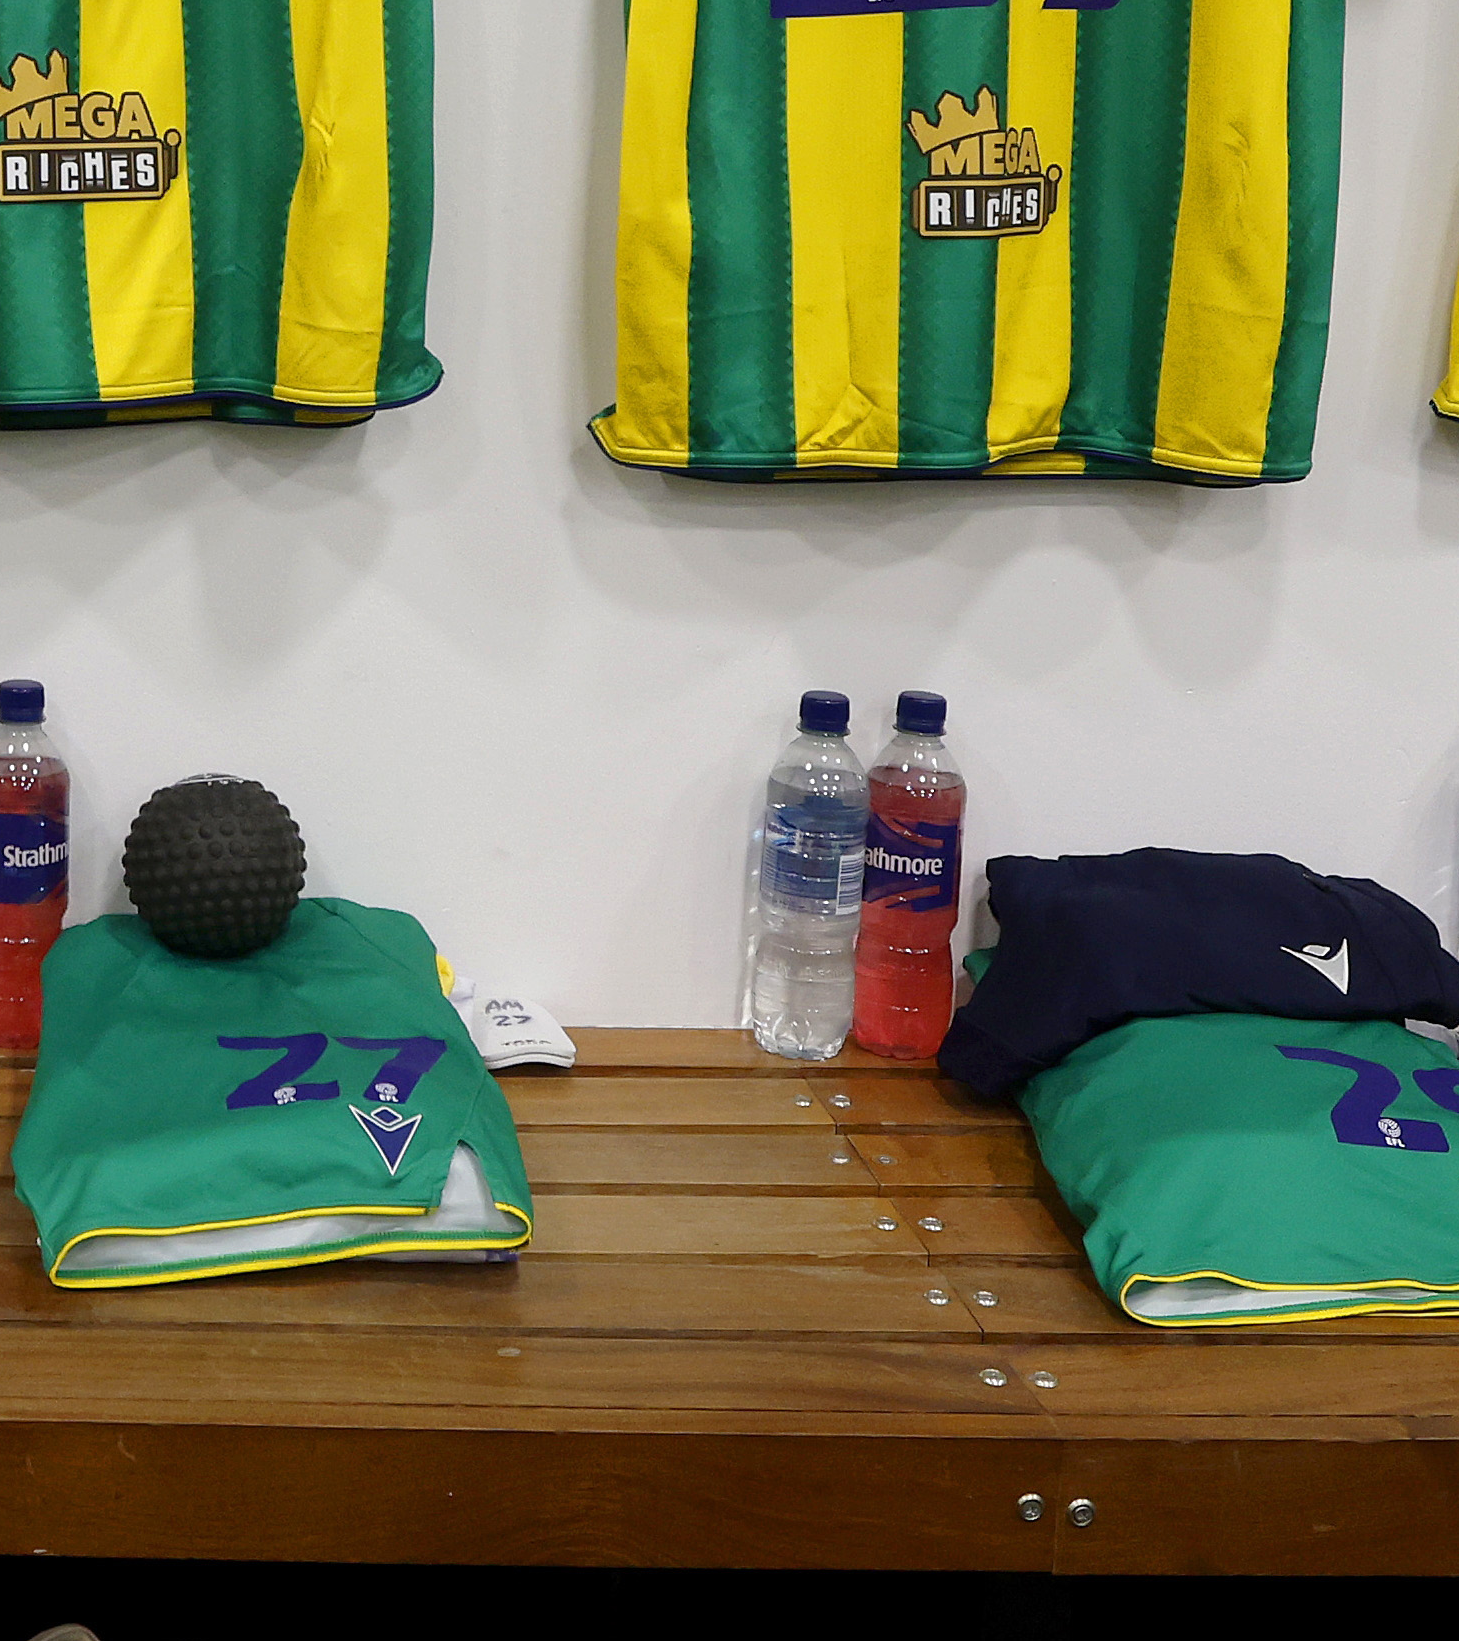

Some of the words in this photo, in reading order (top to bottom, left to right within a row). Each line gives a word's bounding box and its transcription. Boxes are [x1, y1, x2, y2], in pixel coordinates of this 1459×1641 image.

[6, 92, 157, 141] MEGA
[931, 128, 1040, 176] MEGA
[6, 152, 155, 193] RICHES
[929, 188, 1038, 228] RICHES
[3, 842, 69, 868] Strathm
[485, 1000, 524, 1014] AM
[492, 1015, 531, 1027] 27
[217, 1033, 447, 1110] 27
